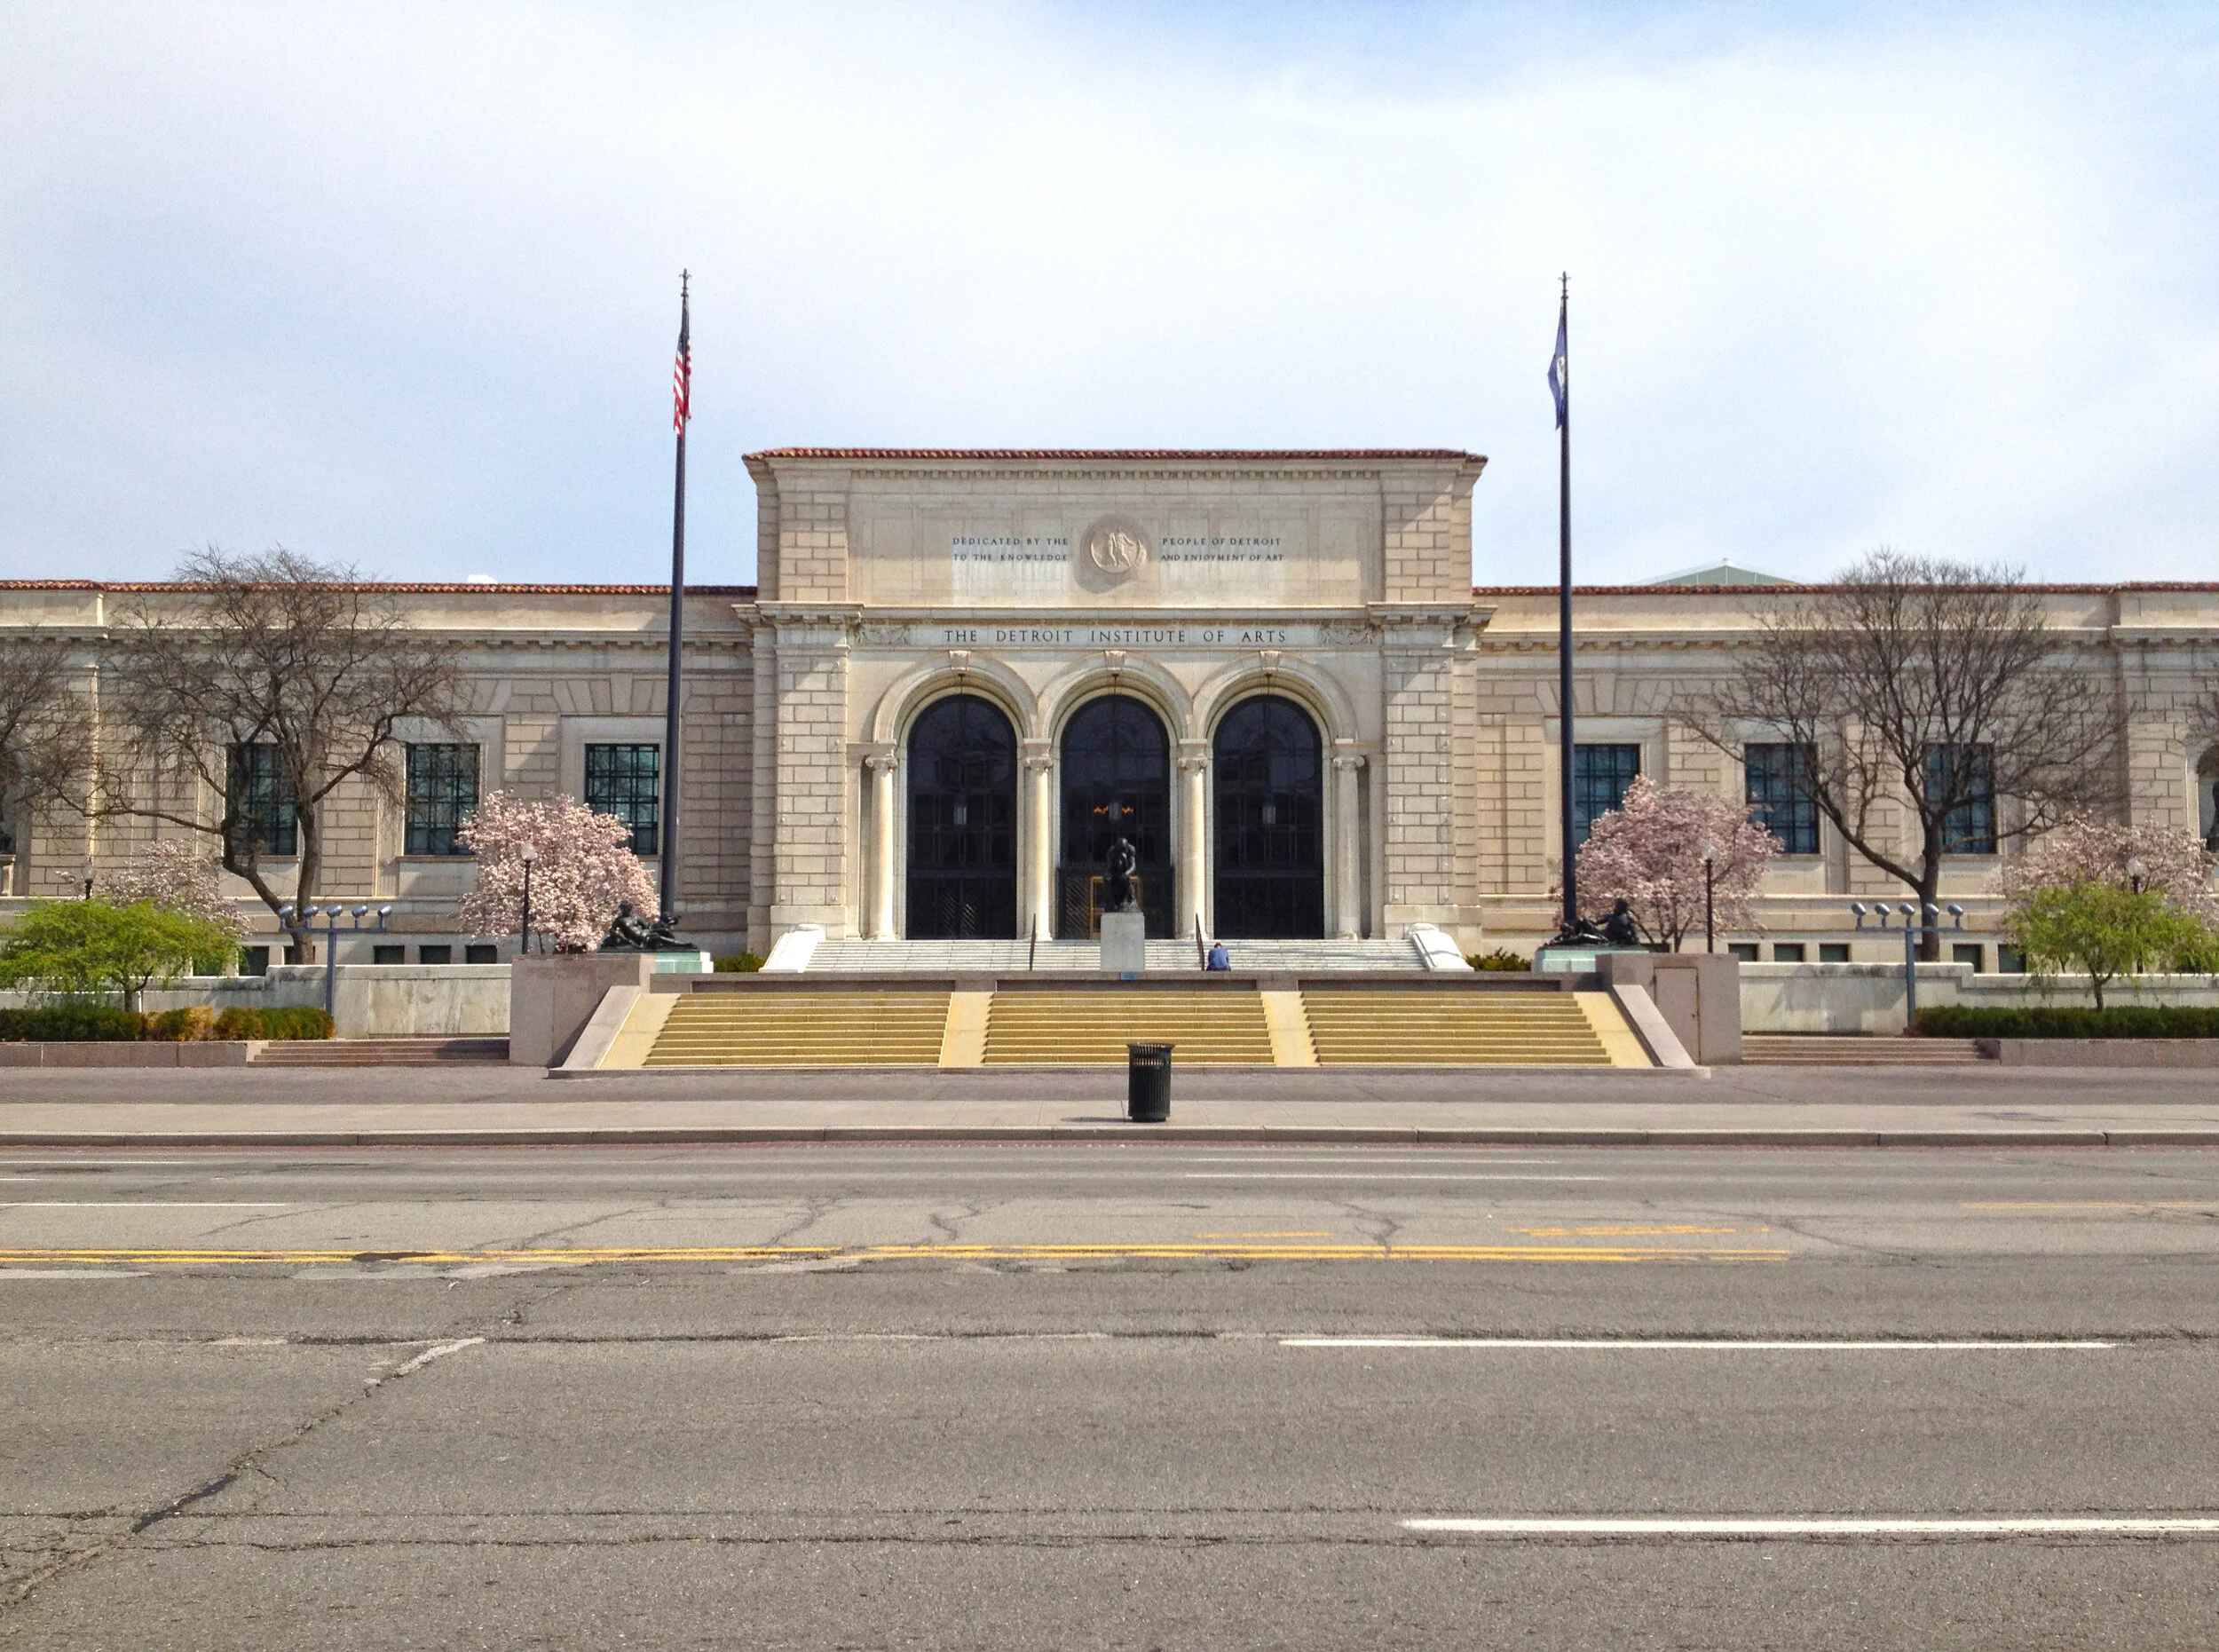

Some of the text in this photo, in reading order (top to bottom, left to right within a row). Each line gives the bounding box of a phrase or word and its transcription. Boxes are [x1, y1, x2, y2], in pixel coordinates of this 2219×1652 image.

[952, 537, 1020, 546] DEDICATED
[1027, 537, 1039, 546] BY
[1046, 537, 1069, 546] THE
[954, 553, 967, 562] TO
[974, 553, 992, 562] THE
[1000, 553, 1068, 562] KNOWLEDGE
[1184, 553, 1245, 562] ENJOYMENT
[1250, 553, 1261, 562] OF
[1267, 553, 1283, 562] ART
[944, 630, 1286, 643] THE DETROIT INSTITUTE OF ARTS
